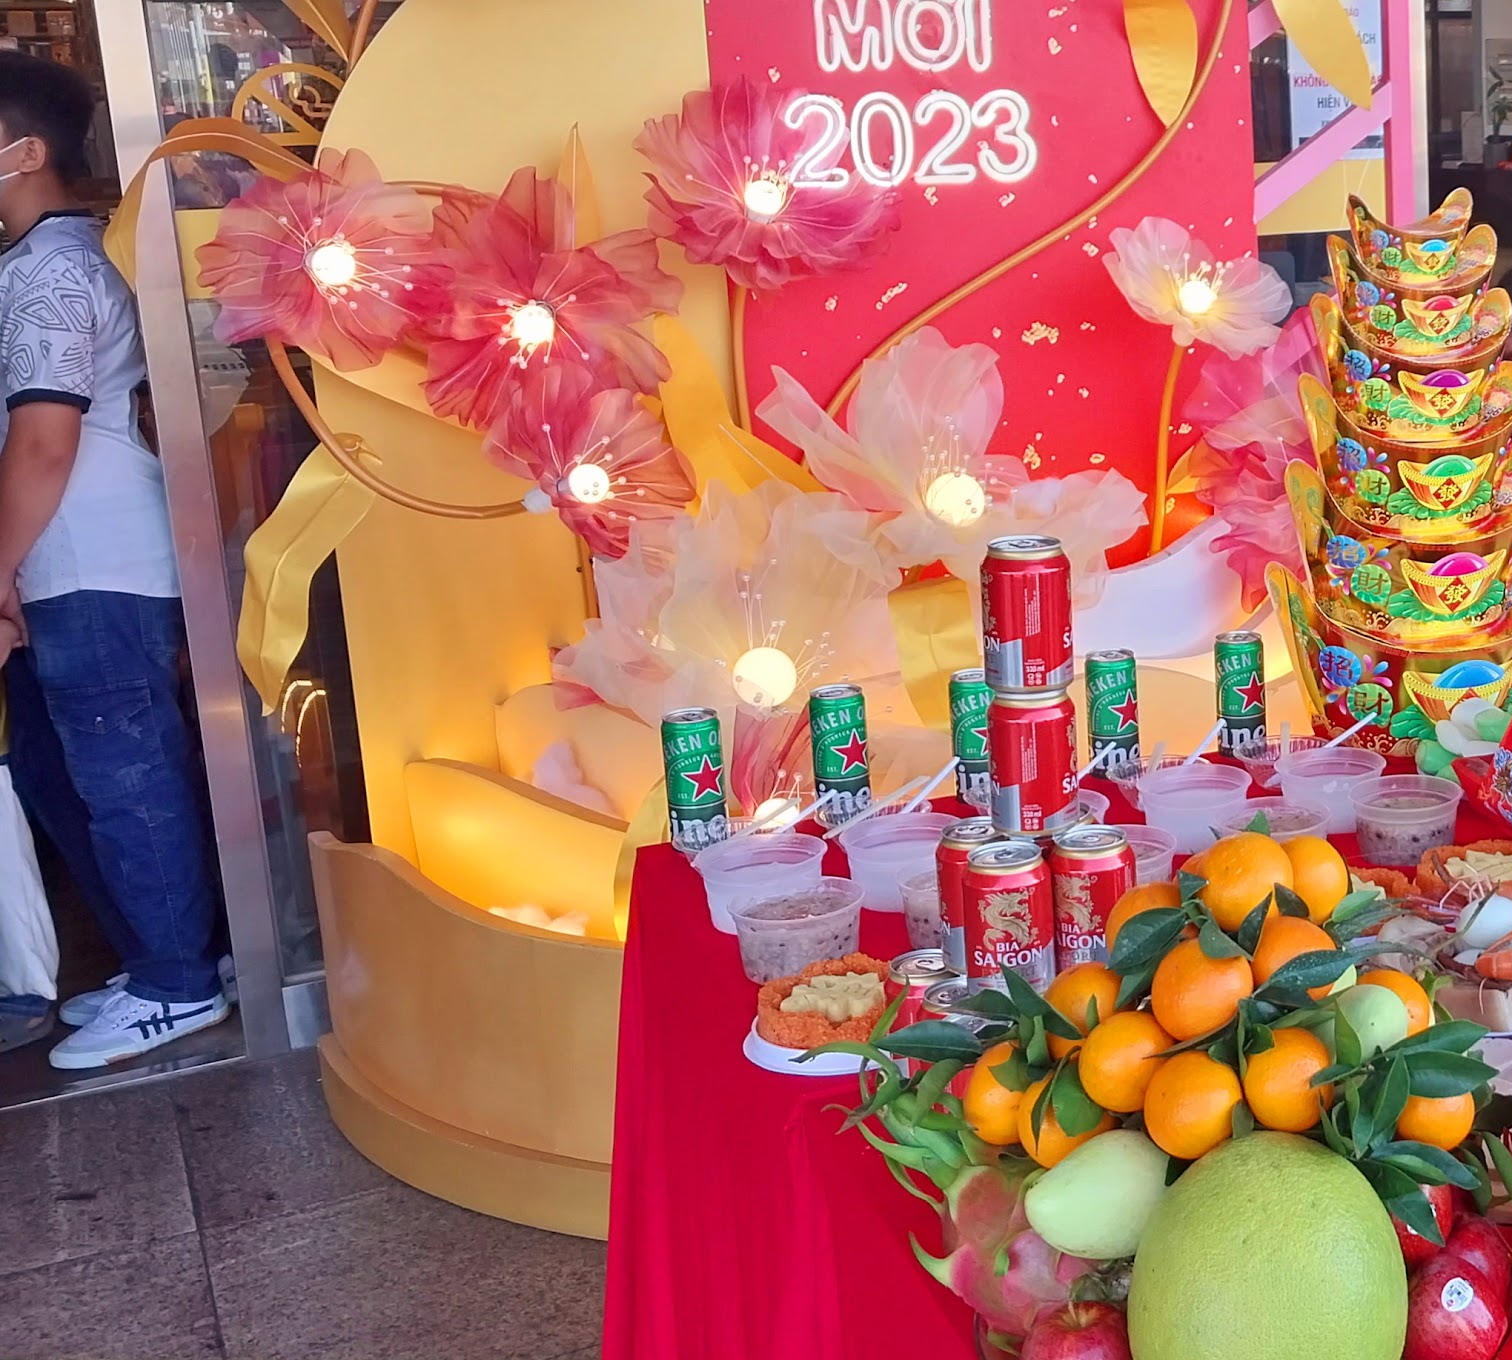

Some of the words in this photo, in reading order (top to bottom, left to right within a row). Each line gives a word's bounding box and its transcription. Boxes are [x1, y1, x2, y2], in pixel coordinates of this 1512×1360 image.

[785, 89, 1037, 187] 2023
[1061, 922, 1081, 934] BIA
[996, 941, 1020, 952] BIA
[974, 946, 1044, 968] SAIGON
